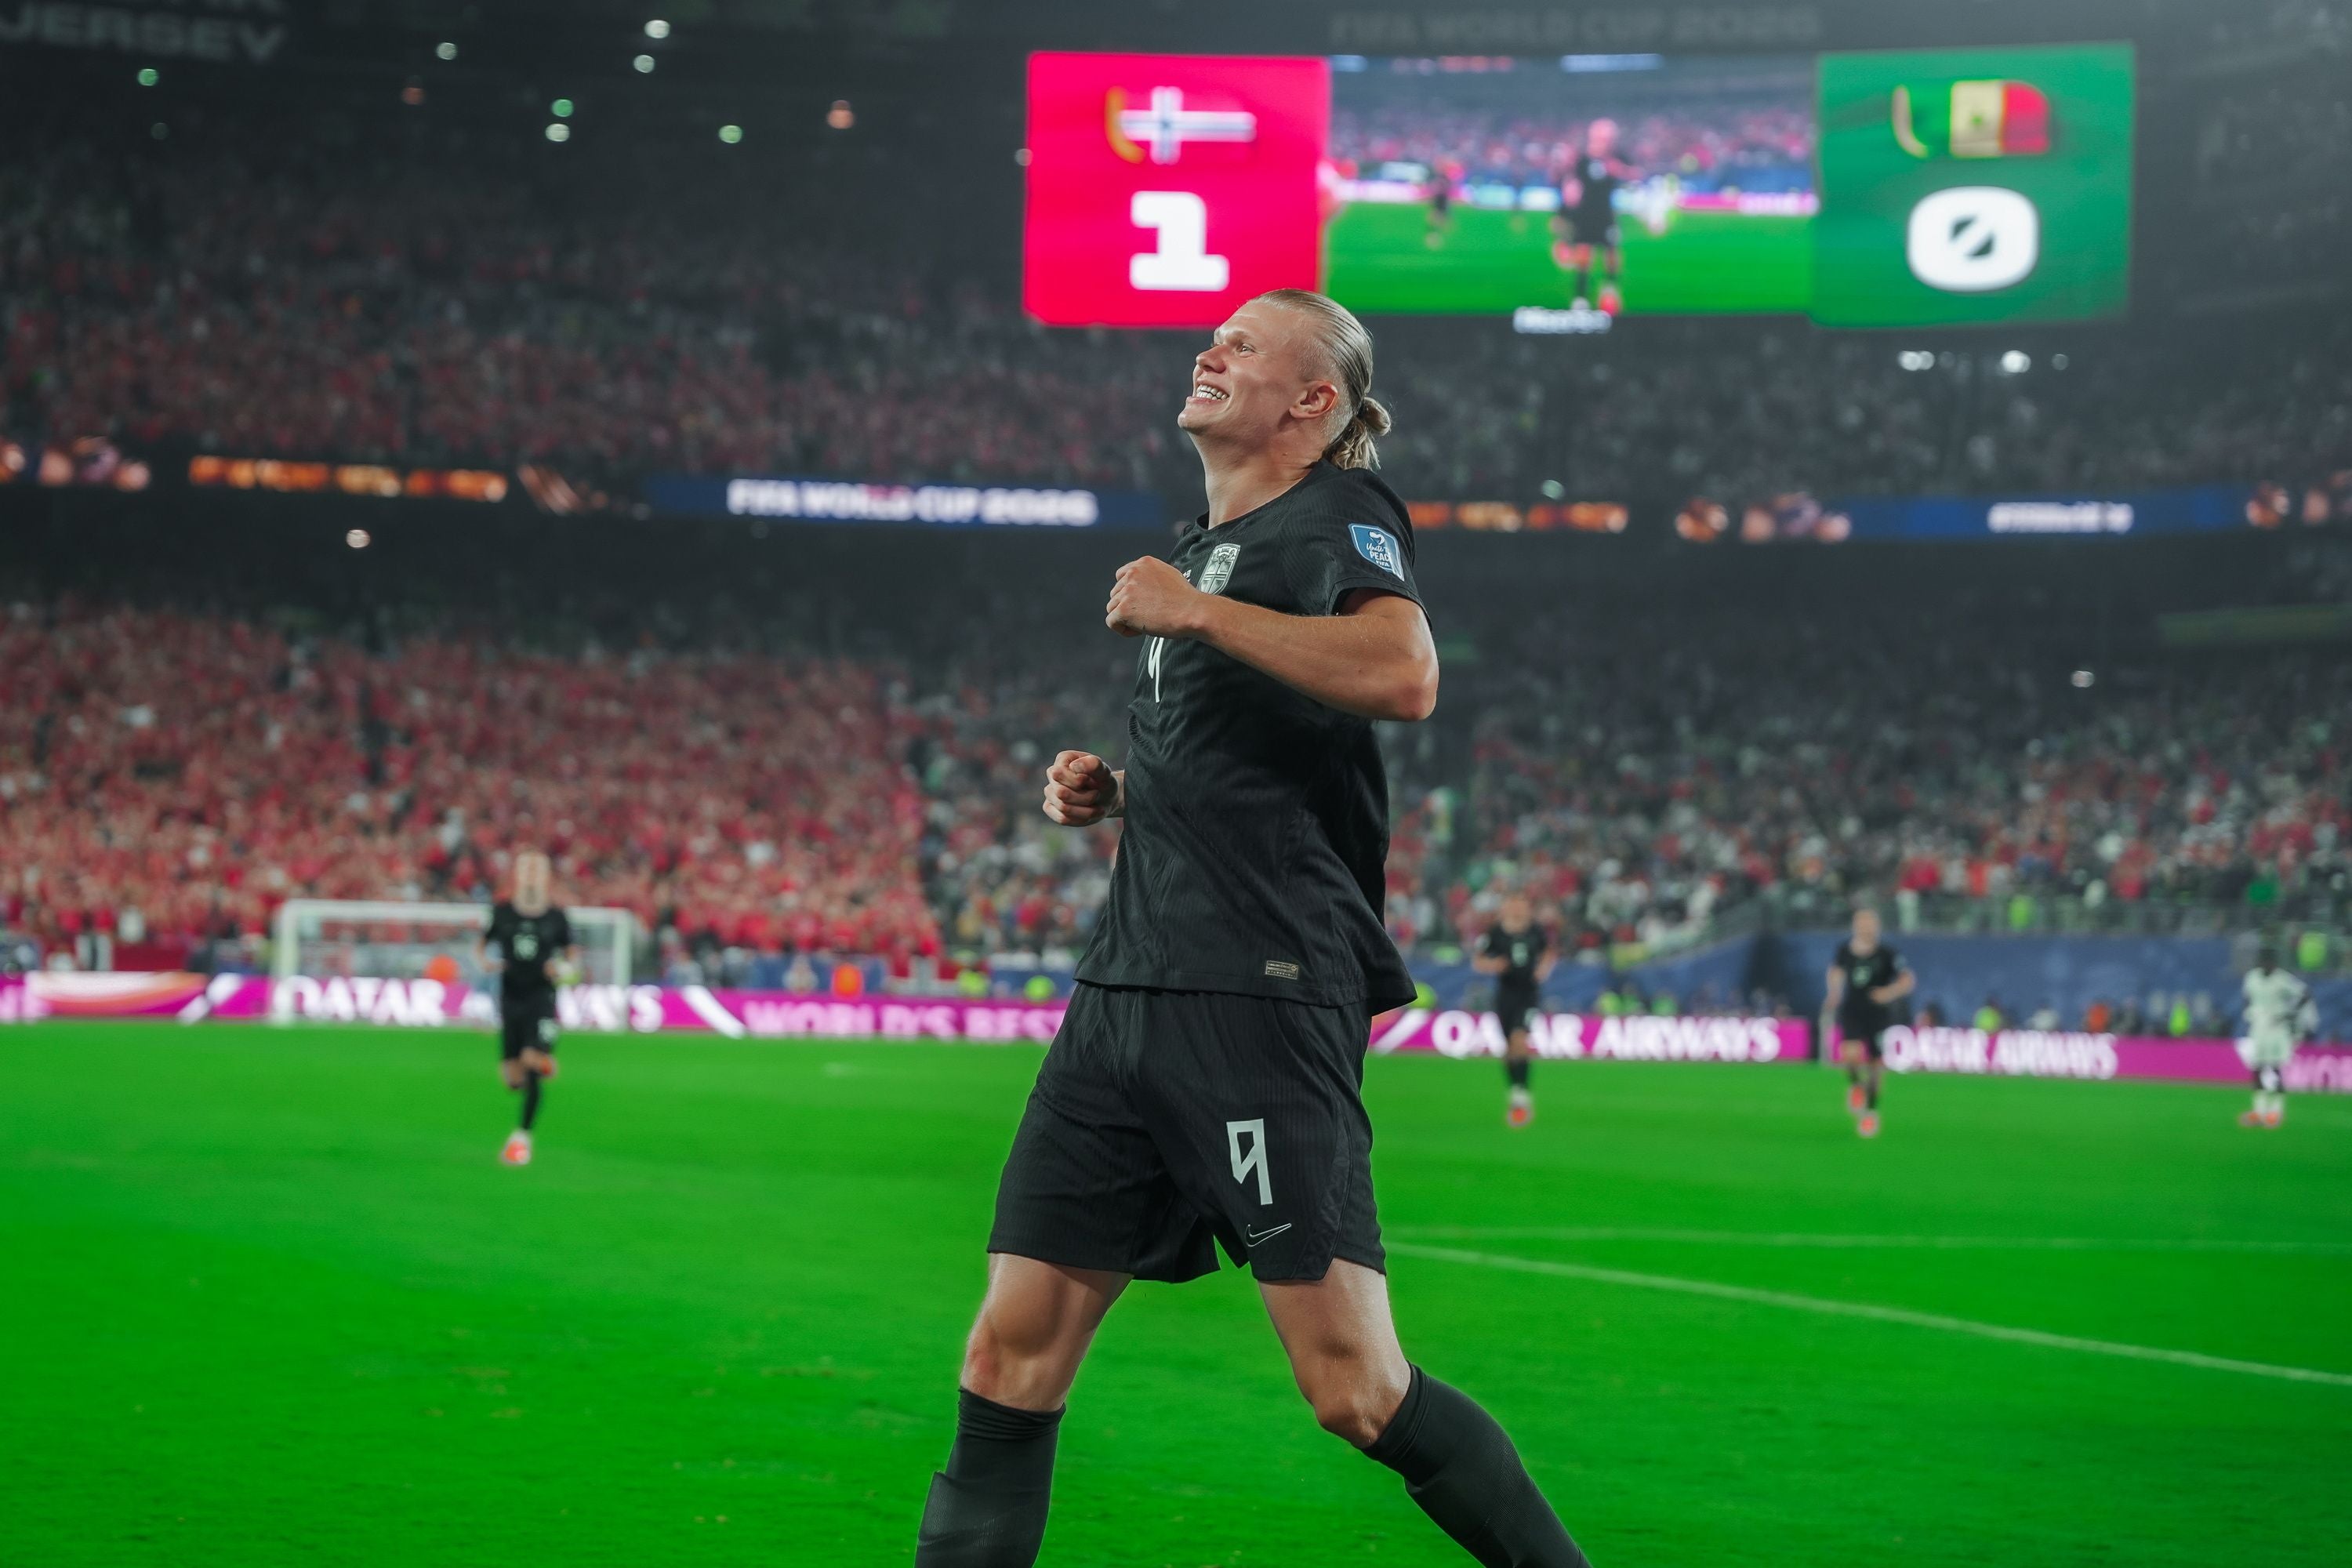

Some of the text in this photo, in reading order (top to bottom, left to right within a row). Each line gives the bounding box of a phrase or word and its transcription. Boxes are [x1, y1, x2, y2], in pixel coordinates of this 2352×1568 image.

[0, 3, 284, 63] JERSEY
[1130, 191, 1229, 291] 1
[1907, 185, 2040, 292] 0
[727, 478, 1098, 526] FIFA WORLD CUP 2026
[1369, 550, 1391, 562] PEAC
[1431, 1010, 1781, 1062] QAAR AIRWAYS
[1882, 1025, 2118, 1080] QATAR AIRWAYS
[1226, 1118, 1273, 1206] 9
